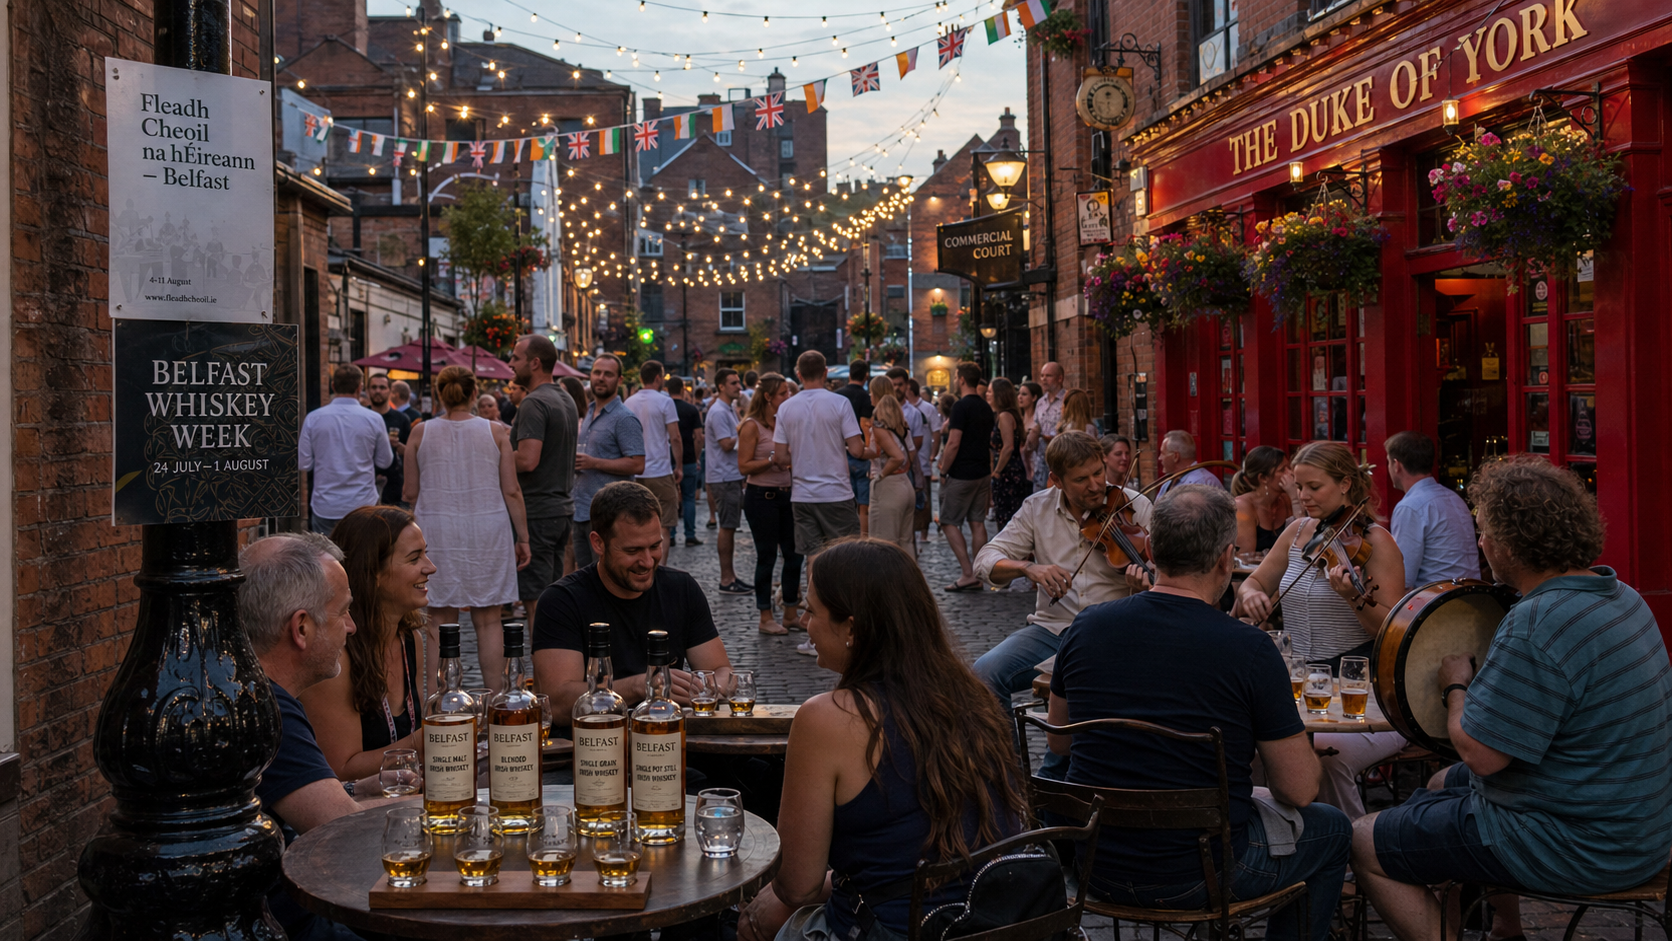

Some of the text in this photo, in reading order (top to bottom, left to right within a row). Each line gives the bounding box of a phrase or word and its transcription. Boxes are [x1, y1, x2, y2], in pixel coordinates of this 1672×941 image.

[1228, 0, 1589, 176] THE DUKE OF YORK
[140, 93, 210, 119] Fleadh
[141, 117, 210, 142] Cheoil
[142, 142, 256, 170] na hÉireann
[163, 167, 230, 191] Belfast
[944, 230, 1013, 249] COMMERCIAL
[973, 244, 1012, 260] COURT
[167, 277, 192, 287] August
[152, 359, 268, 386] BELFAST
[145, 392, 275, 417] WHISKEY
[170, 424, 252, 449] WEEK
[153, 461, 169, 474] 24
[223, 458, 270, 471] AUGUST
[429, 732, 469, 743] BELFAST
[494, 732, 533, 743] BELFAST
[579, 736, 619, 747] BELFAST
[636, 742, 676, 752] BELFAST
